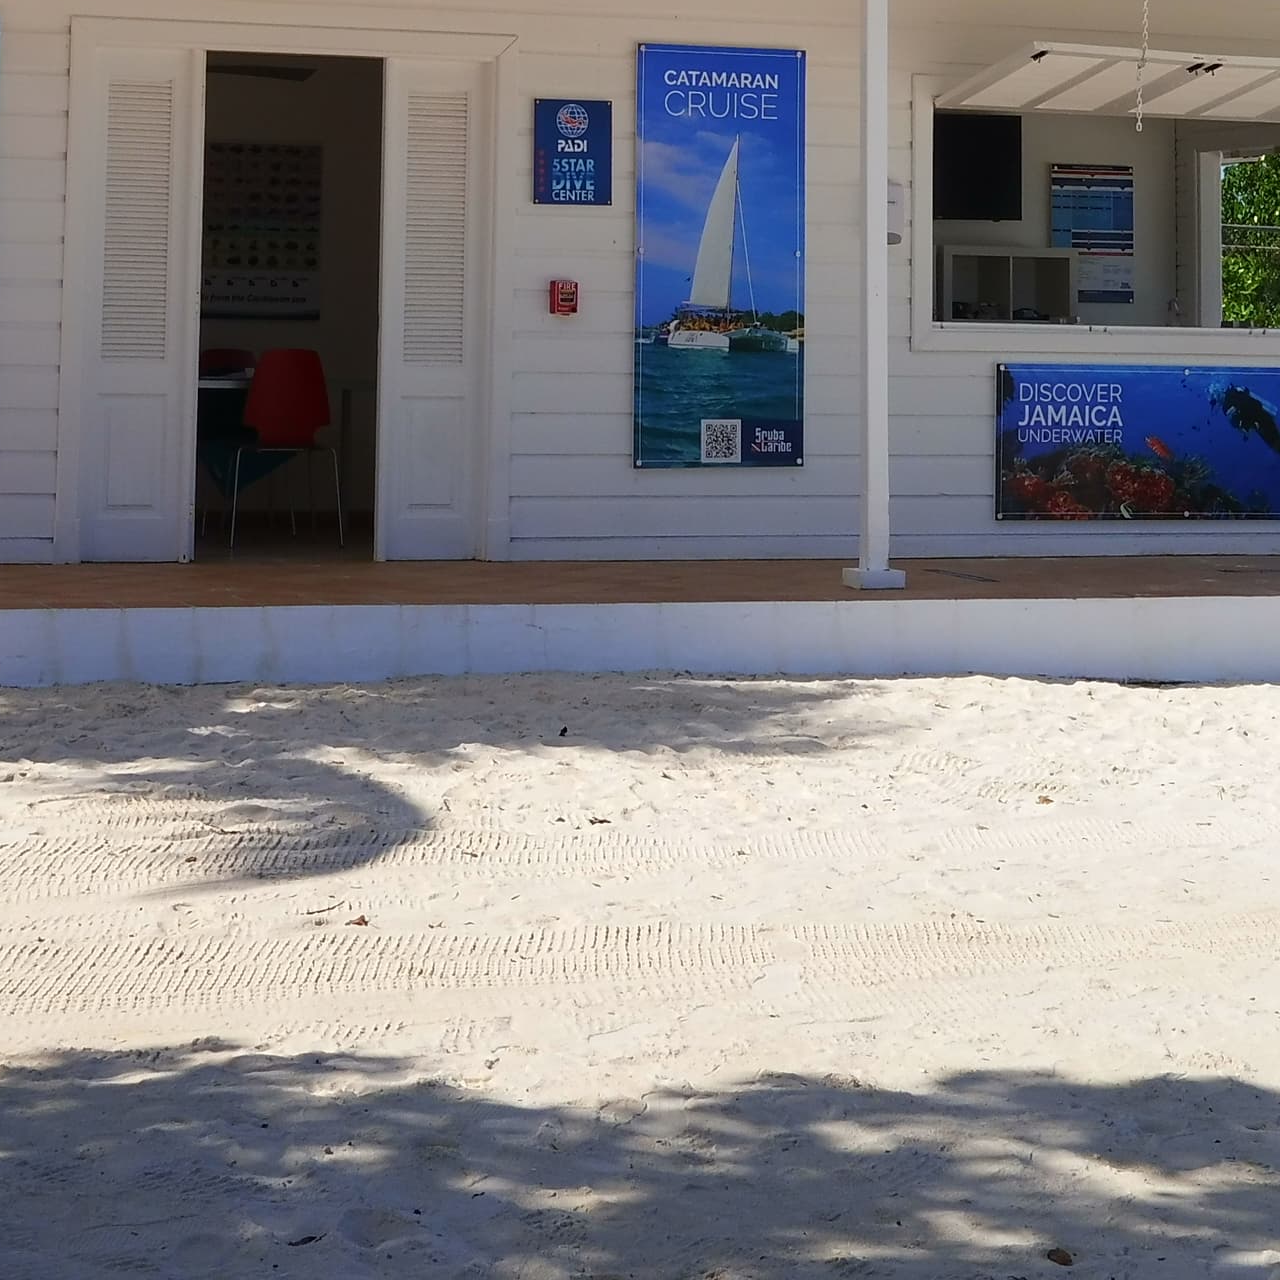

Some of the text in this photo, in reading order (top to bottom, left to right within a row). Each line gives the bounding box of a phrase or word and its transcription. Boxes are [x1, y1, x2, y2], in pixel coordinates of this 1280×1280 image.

[664, 70, 779, 89] CATAMARAN
[664, 90, 778, 120] CRUISE
[557, 140, 587, 152] PADI
[552, 172, 595, 190] DIVE
[552, 190, 595, 201] CENTER
[559, 281, 577, 290] FIRE
[1020, 383, 1123, 403] DISCOVER
[1018, 404, 1123, 427] JAMAICA
[755, 427, 785, 443] Scuba
[1017, 428, 1123, 444] UNDERWATER
